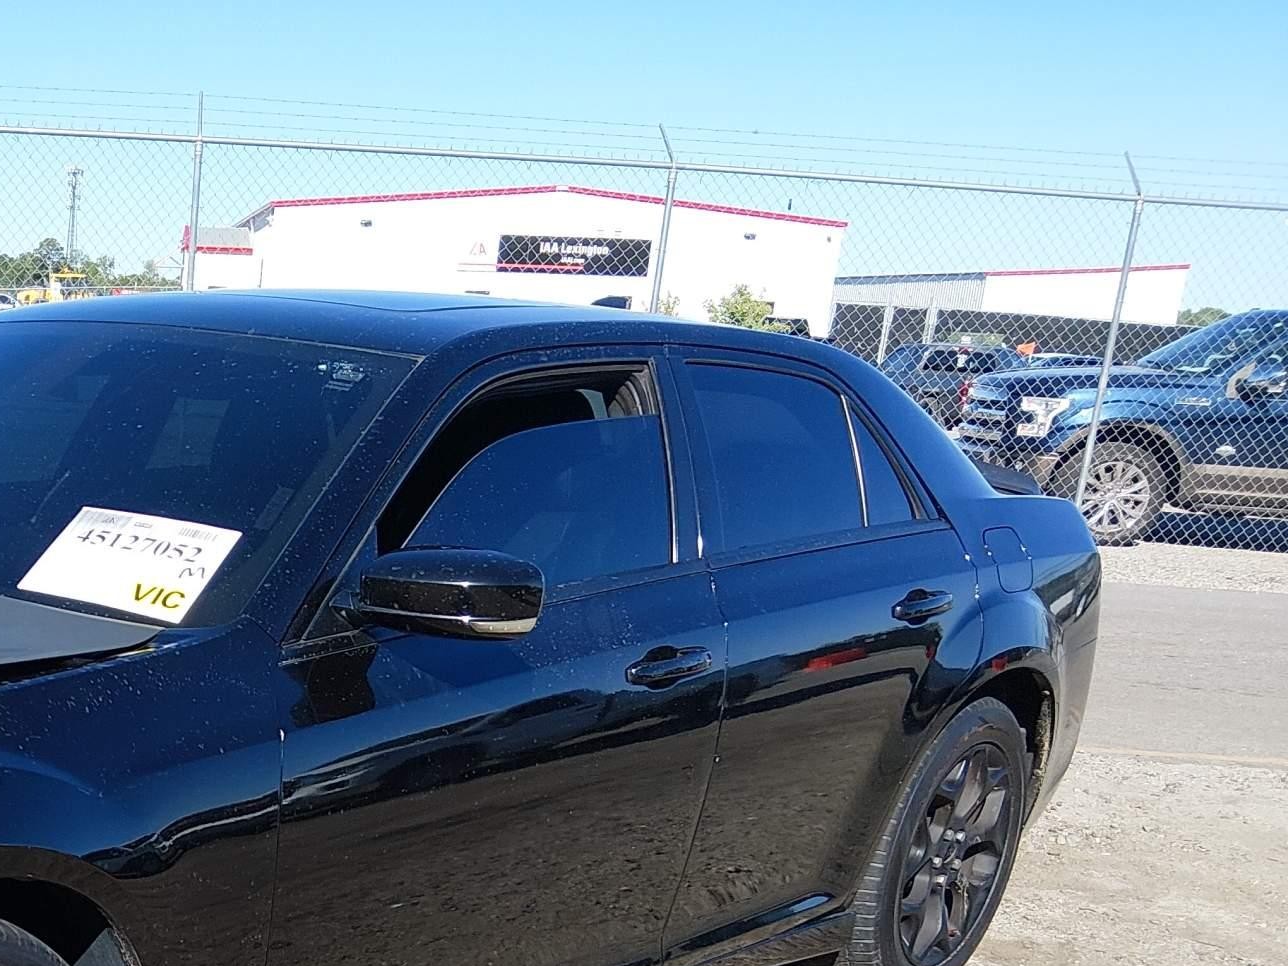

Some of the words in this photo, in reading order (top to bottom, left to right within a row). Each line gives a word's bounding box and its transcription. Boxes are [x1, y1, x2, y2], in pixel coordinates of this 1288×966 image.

[540, 241, 559, 254] IAA
[560, 242, 609, 257] Lexington
[77, 528, 202, 563] 45127052
[134, 583, 185, 609] VIC
